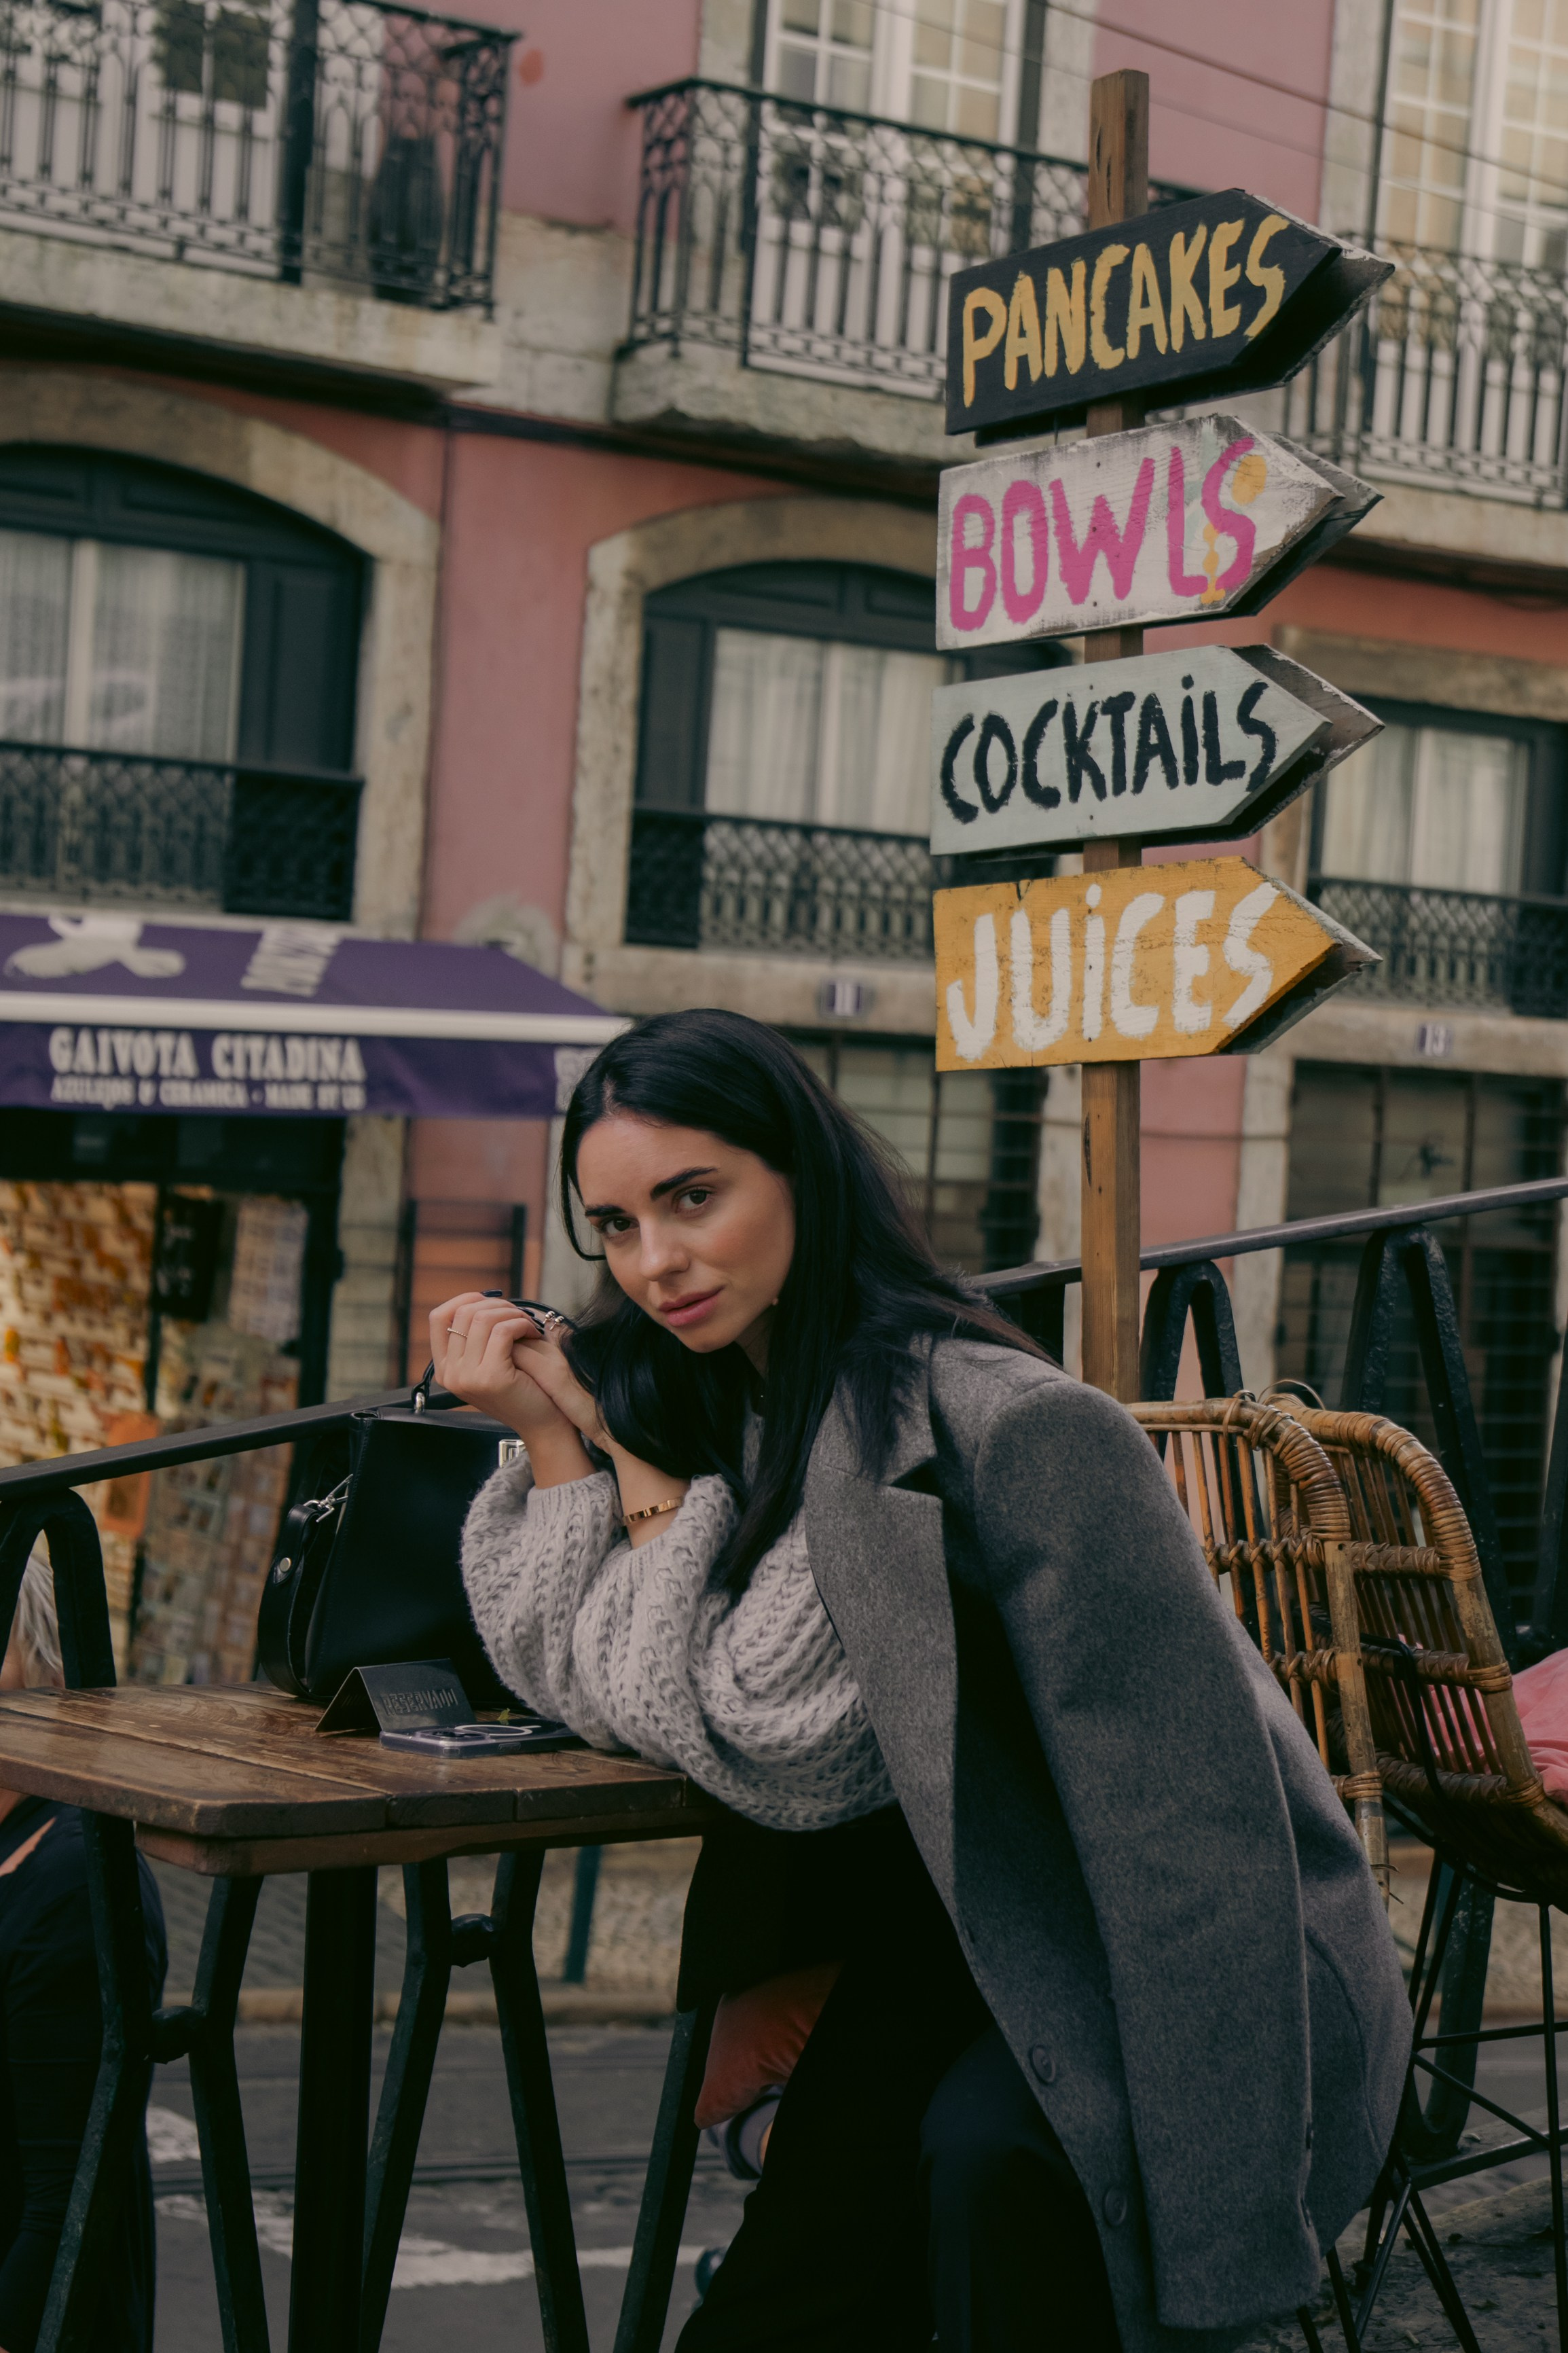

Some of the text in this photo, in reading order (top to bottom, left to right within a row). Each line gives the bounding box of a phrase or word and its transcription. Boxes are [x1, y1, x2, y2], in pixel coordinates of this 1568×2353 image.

[962, 213, 1290, 408] PANCAKES
[949, 436, 1256, 632] BOWLS
[49, 1027, 367, 1083] GAIVOTA CITADINA
